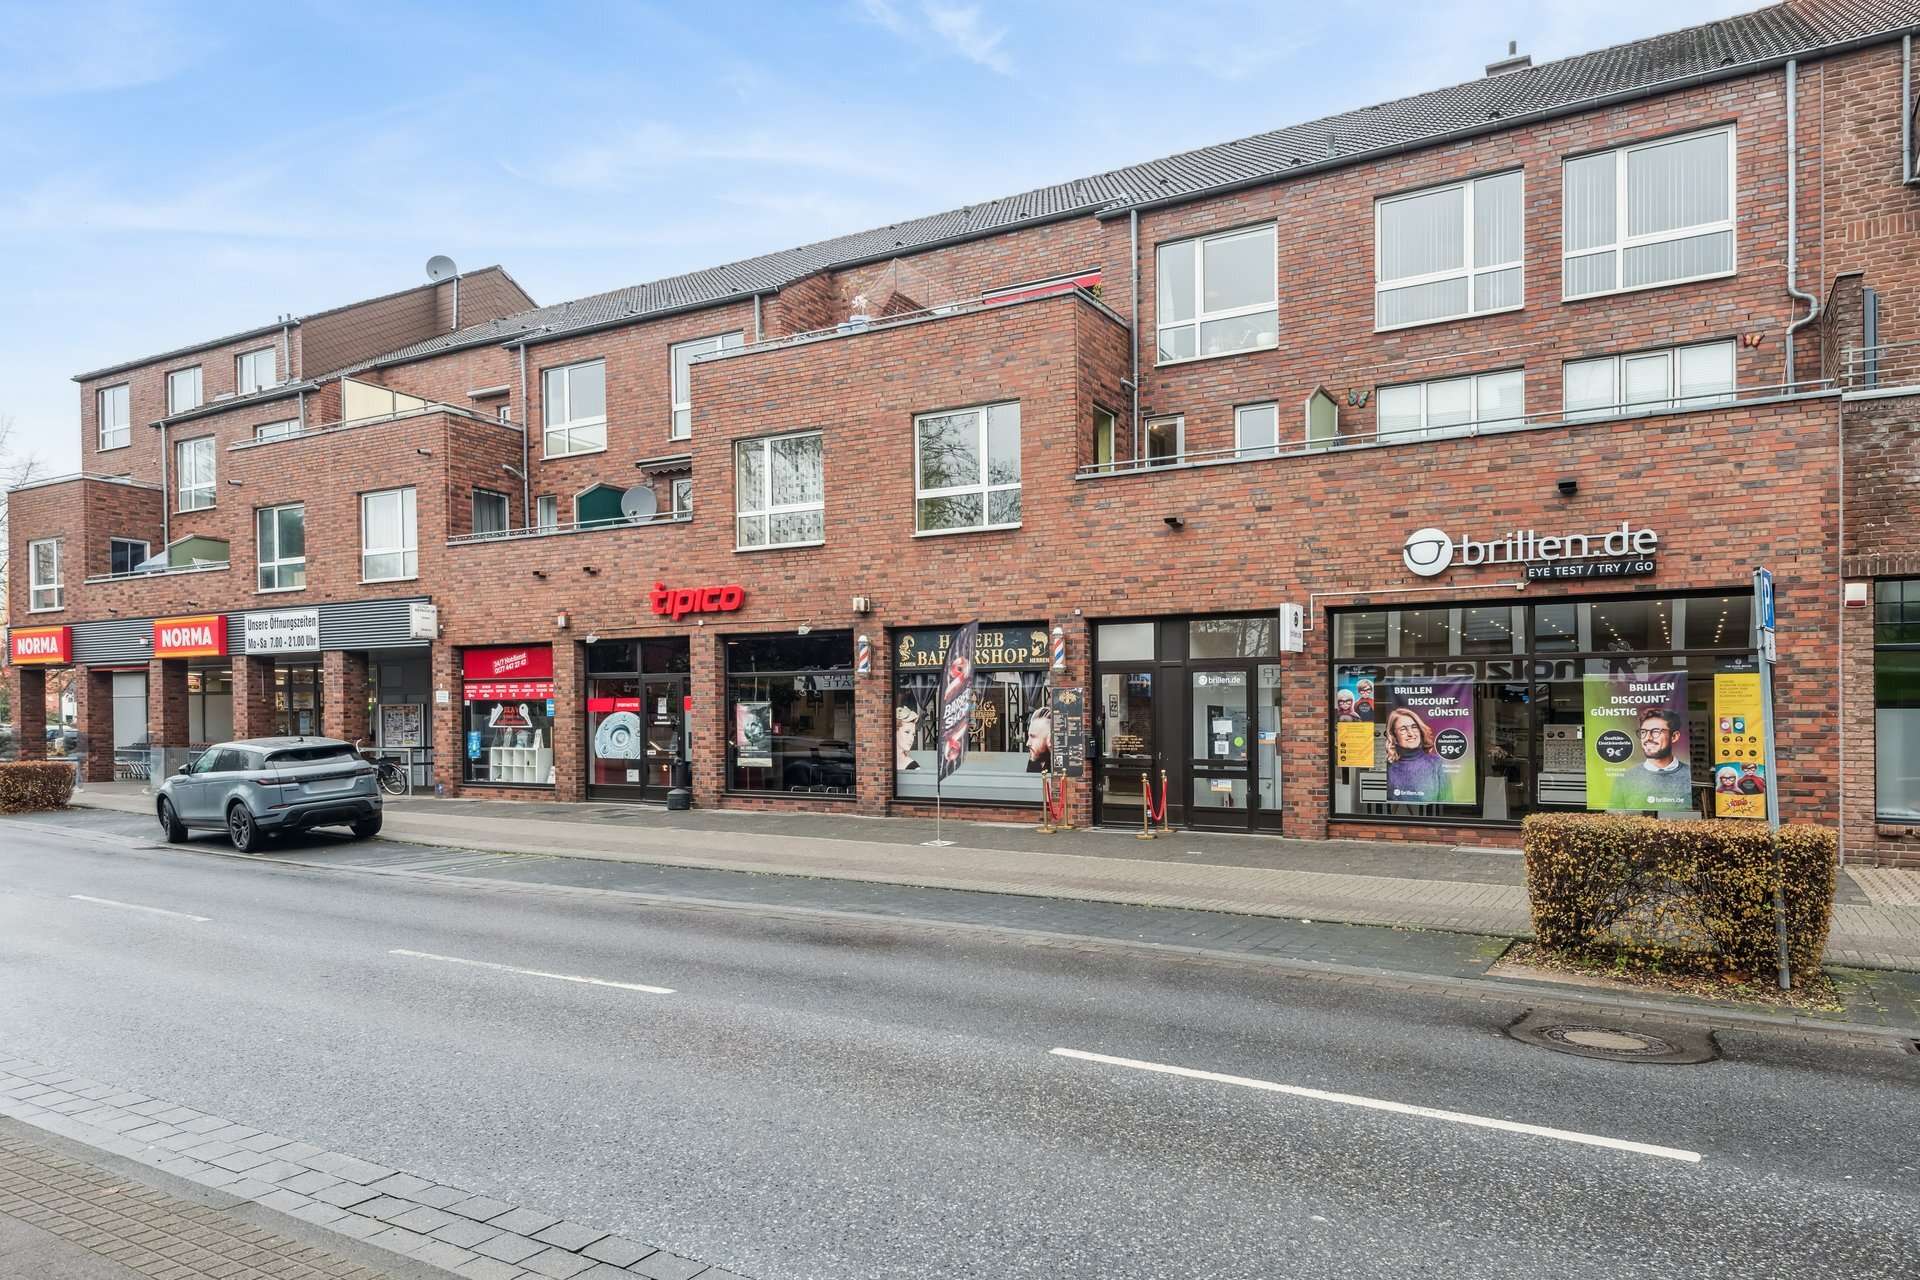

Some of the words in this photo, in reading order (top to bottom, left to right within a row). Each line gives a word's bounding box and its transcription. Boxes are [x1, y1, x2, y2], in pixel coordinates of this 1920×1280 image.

[1462, 522, 1658, 565] brillen.de
[1528, 567, 1550, 577] EYE
[1554, 565, 1584, 576] TEST
[1597, 563, 1621, 574] TRY
[1634, 561, 1654, 572] GO
[649, 582, 745, 621] tipico
[1763, 577, 1771, 622] P
[247, 618, 269, 631] Unsere
[269, 614, 317, 631] Öffnungszeiten
[161, 626, 212, 648] NORMA
[288, 635, 305, 648] 21.00
[305, 635, 317, 647] Uhr
[939, 632, 1004, 649] HEEB
[17, 636, 58, 655] NORMA
[1208, 676, 1241, 684] brillen.de
[1629, 682, 1675, 692] BRILLEN
[1394, 686, 1432, 694] BRILLEN
[1408, 697, 1459, 706] DISCOUNT-
[1611, 695, 1670, 704] DISCOUNT-
[1428, 707, 1469, 717] GÜNSTIG
[1591, 706, 1637, 717] GÜNSTIG
